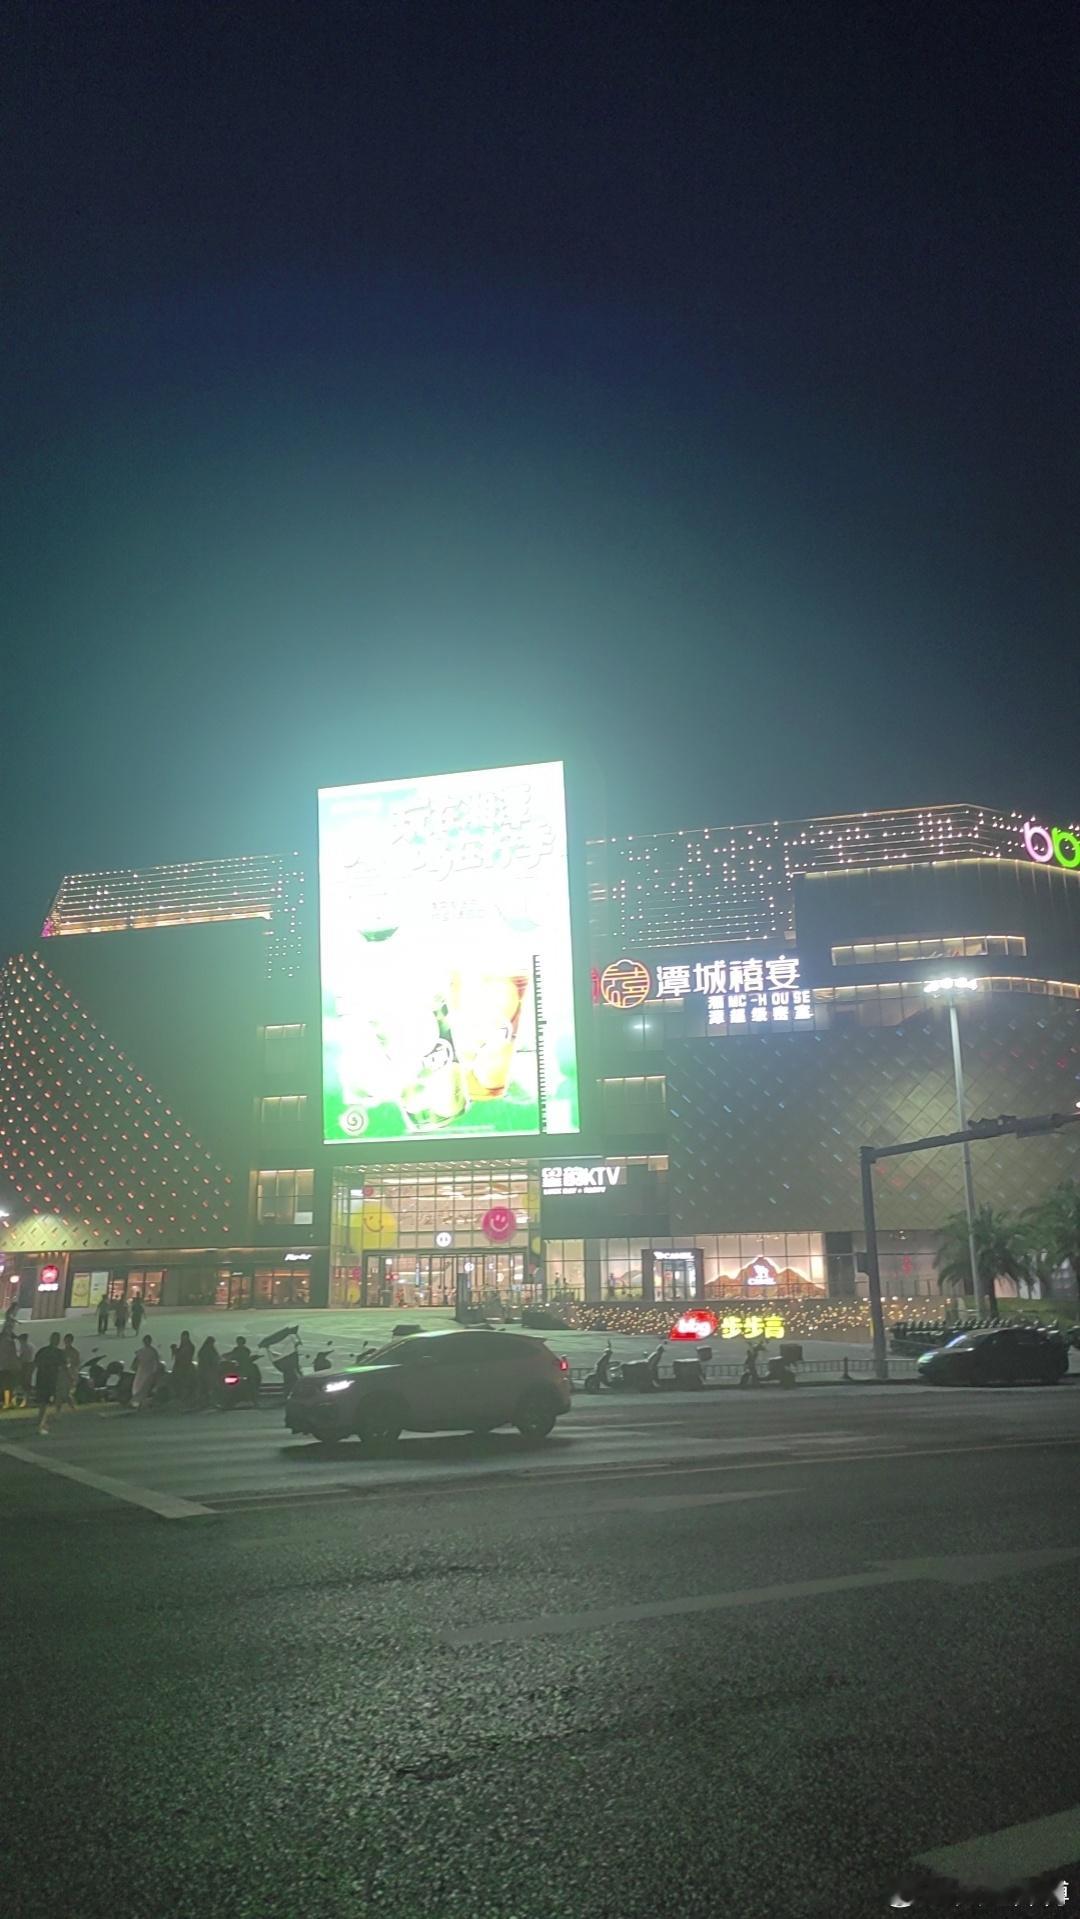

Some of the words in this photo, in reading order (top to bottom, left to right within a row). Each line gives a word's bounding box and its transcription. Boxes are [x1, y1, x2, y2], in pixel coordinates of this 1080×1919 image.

[655, 955, 801, 998] 潭城禧宴
[720, 1314, 785, 1339] 步步高
